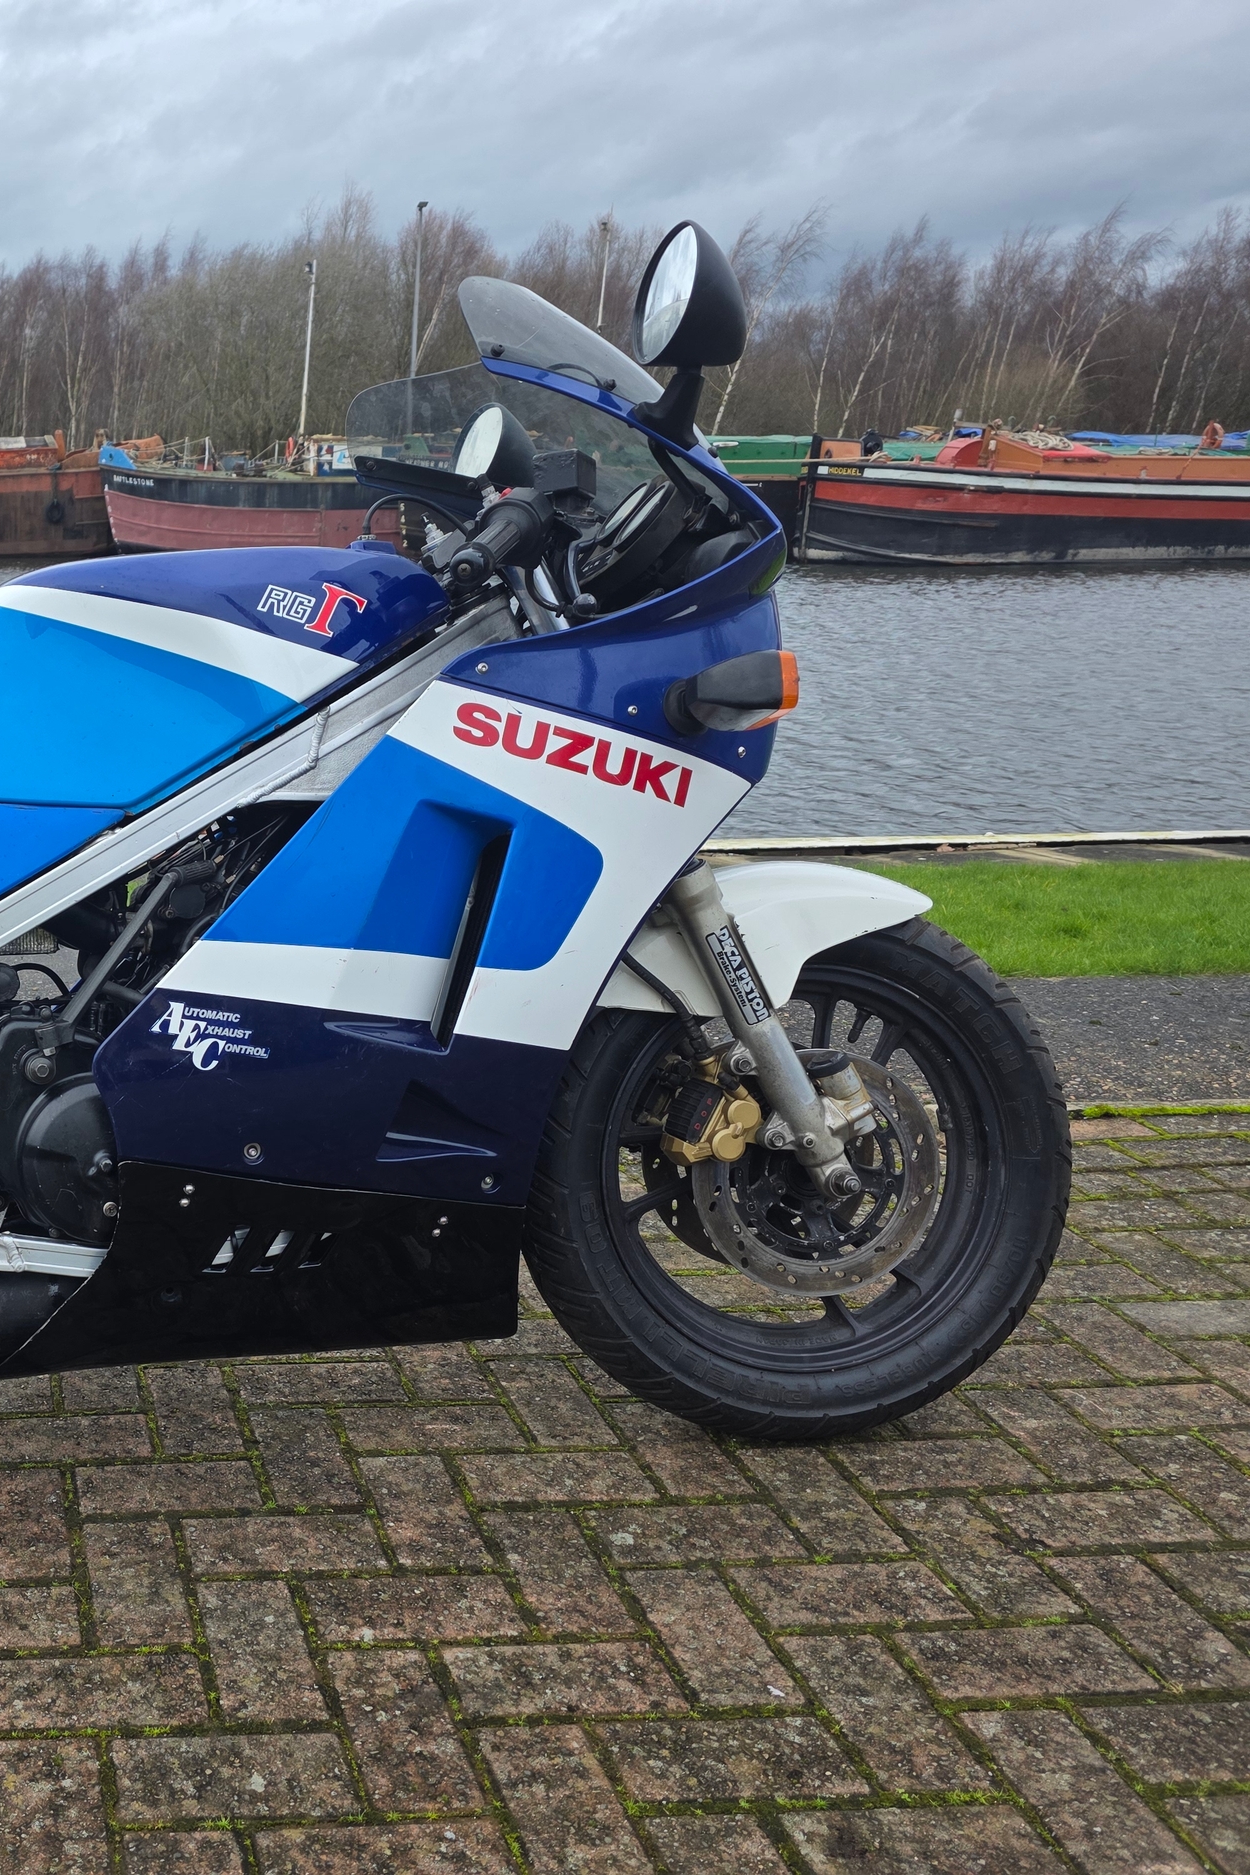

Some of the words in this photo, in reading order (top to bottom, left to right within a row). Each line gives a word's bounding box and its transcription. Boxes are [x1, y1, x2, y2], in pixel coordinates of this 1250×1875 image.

[453, 702, 693, 808] SUZUKI
[718, 926, 743, 969] DECA
[735, 967, 771, 1021] PISTON
[149, 1001, 241, 1035] AUTOMATIC
[172, 1018, 253, 1052] EXHAUST
[887, 944, 1023, 1076] MATCH
[192, 1038, 269, 1071] CONTROL
[637, 1319, 812, 1404] PIRELLI
[838, 1347, 939, 1399] TUBELESS
